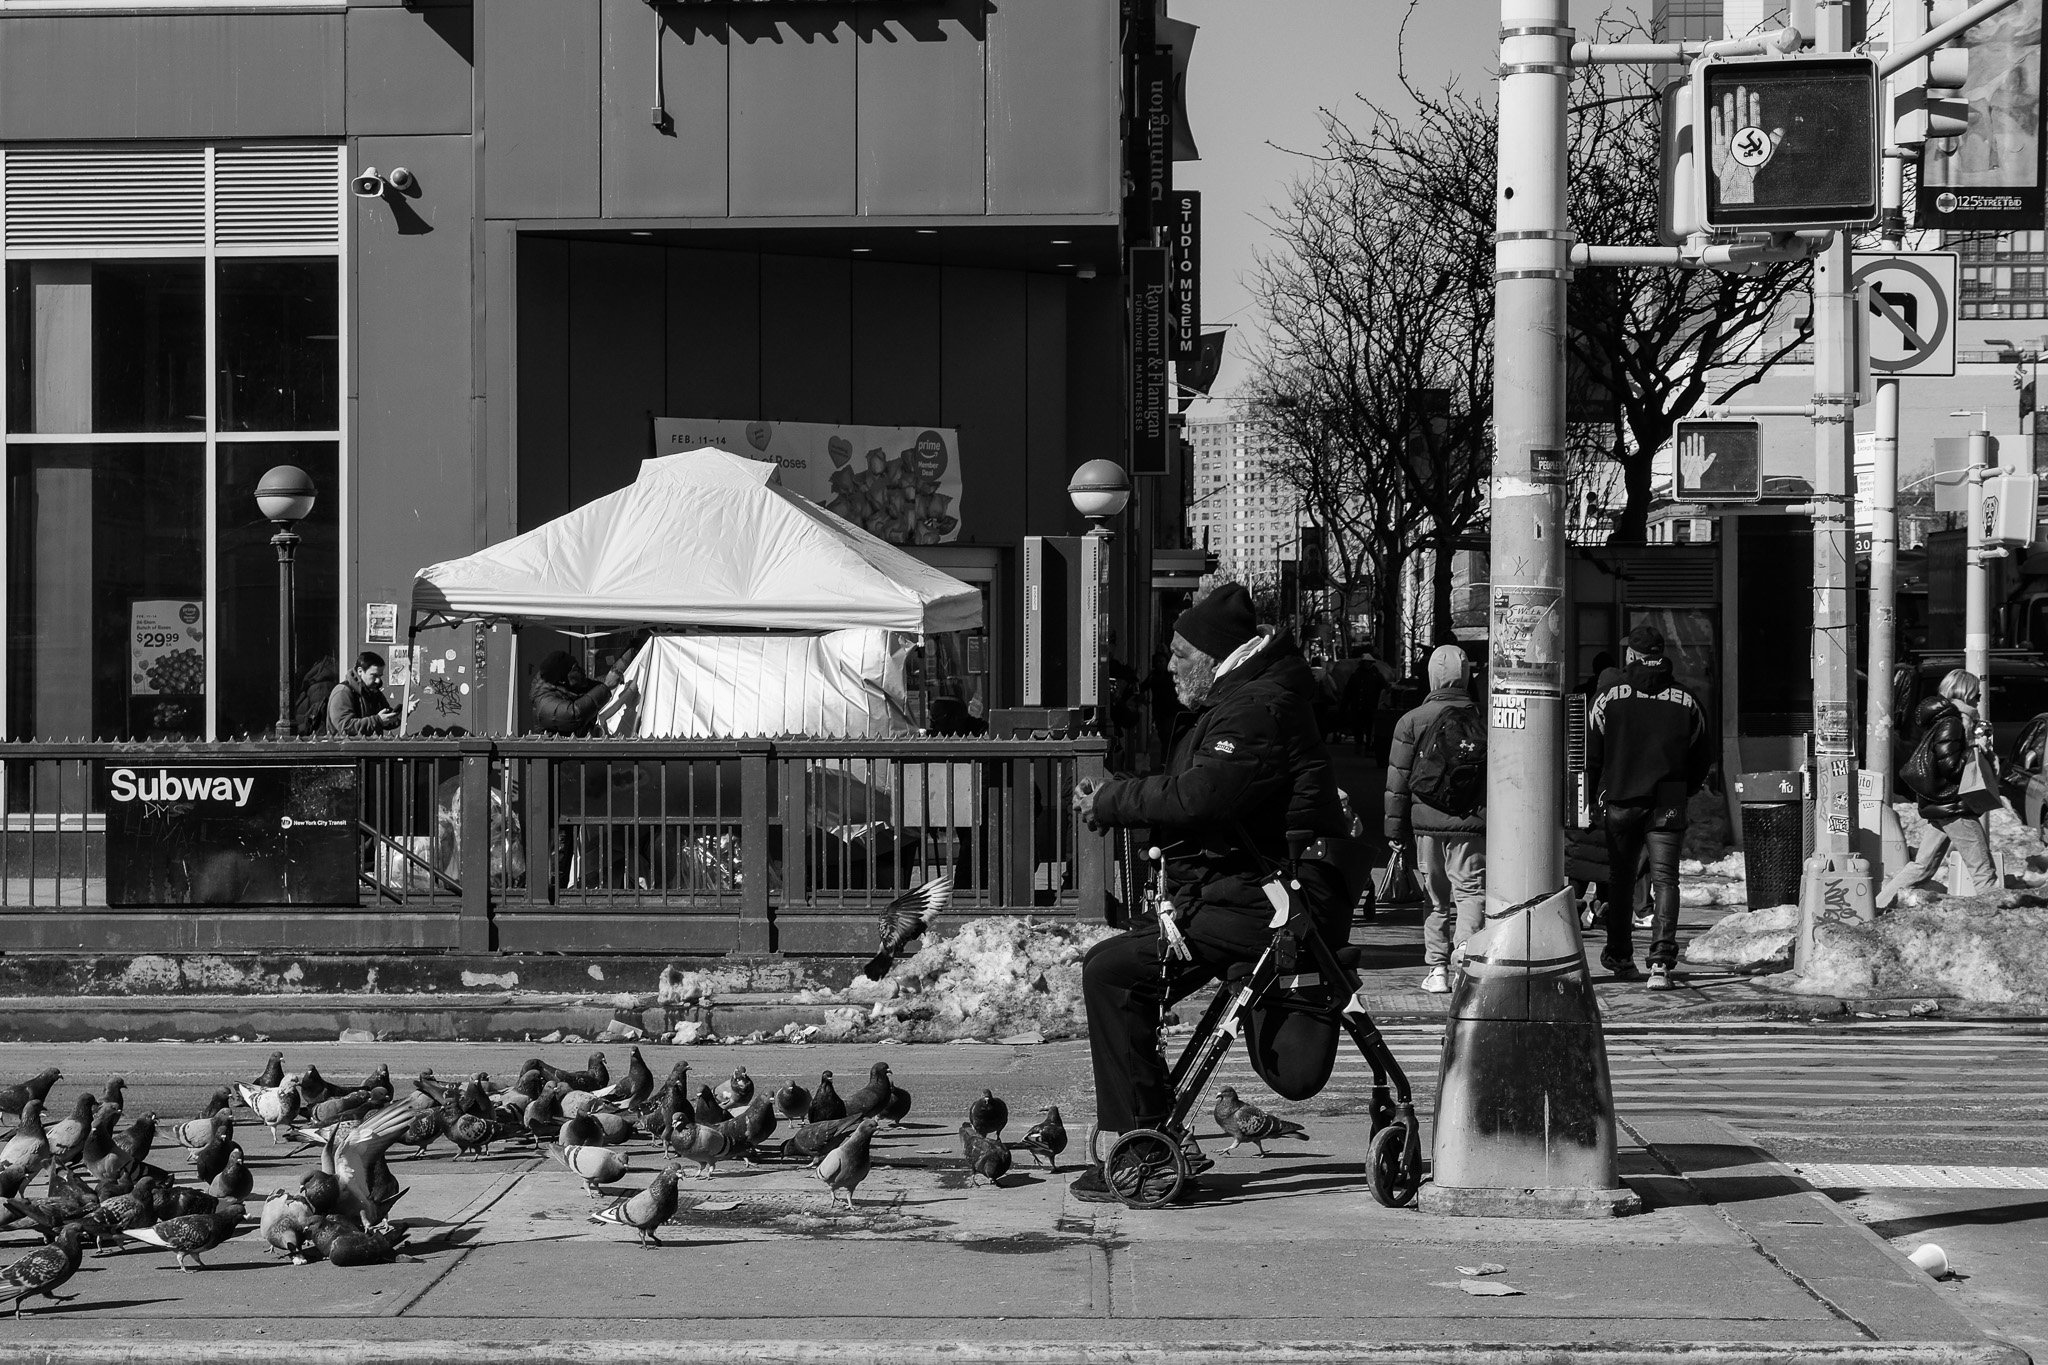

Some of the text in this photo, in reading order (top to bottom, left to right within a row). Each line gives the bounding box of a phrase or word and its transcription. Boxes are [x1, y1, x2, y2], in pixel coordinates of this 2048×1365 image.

[1180, 198, 1192, 352] STUDIO MUSEUM
[1135, 294, 1143, 431] FURNITURE MATTRESSES
[1144, 284, 1164, 438] Raymour & Flanigan
[671, 434, 694, 444] FEB.
[918, 440, 940, 451] prime
[775, 456, 806, 469] Roses
[110, 768, 254, 808] Subway
